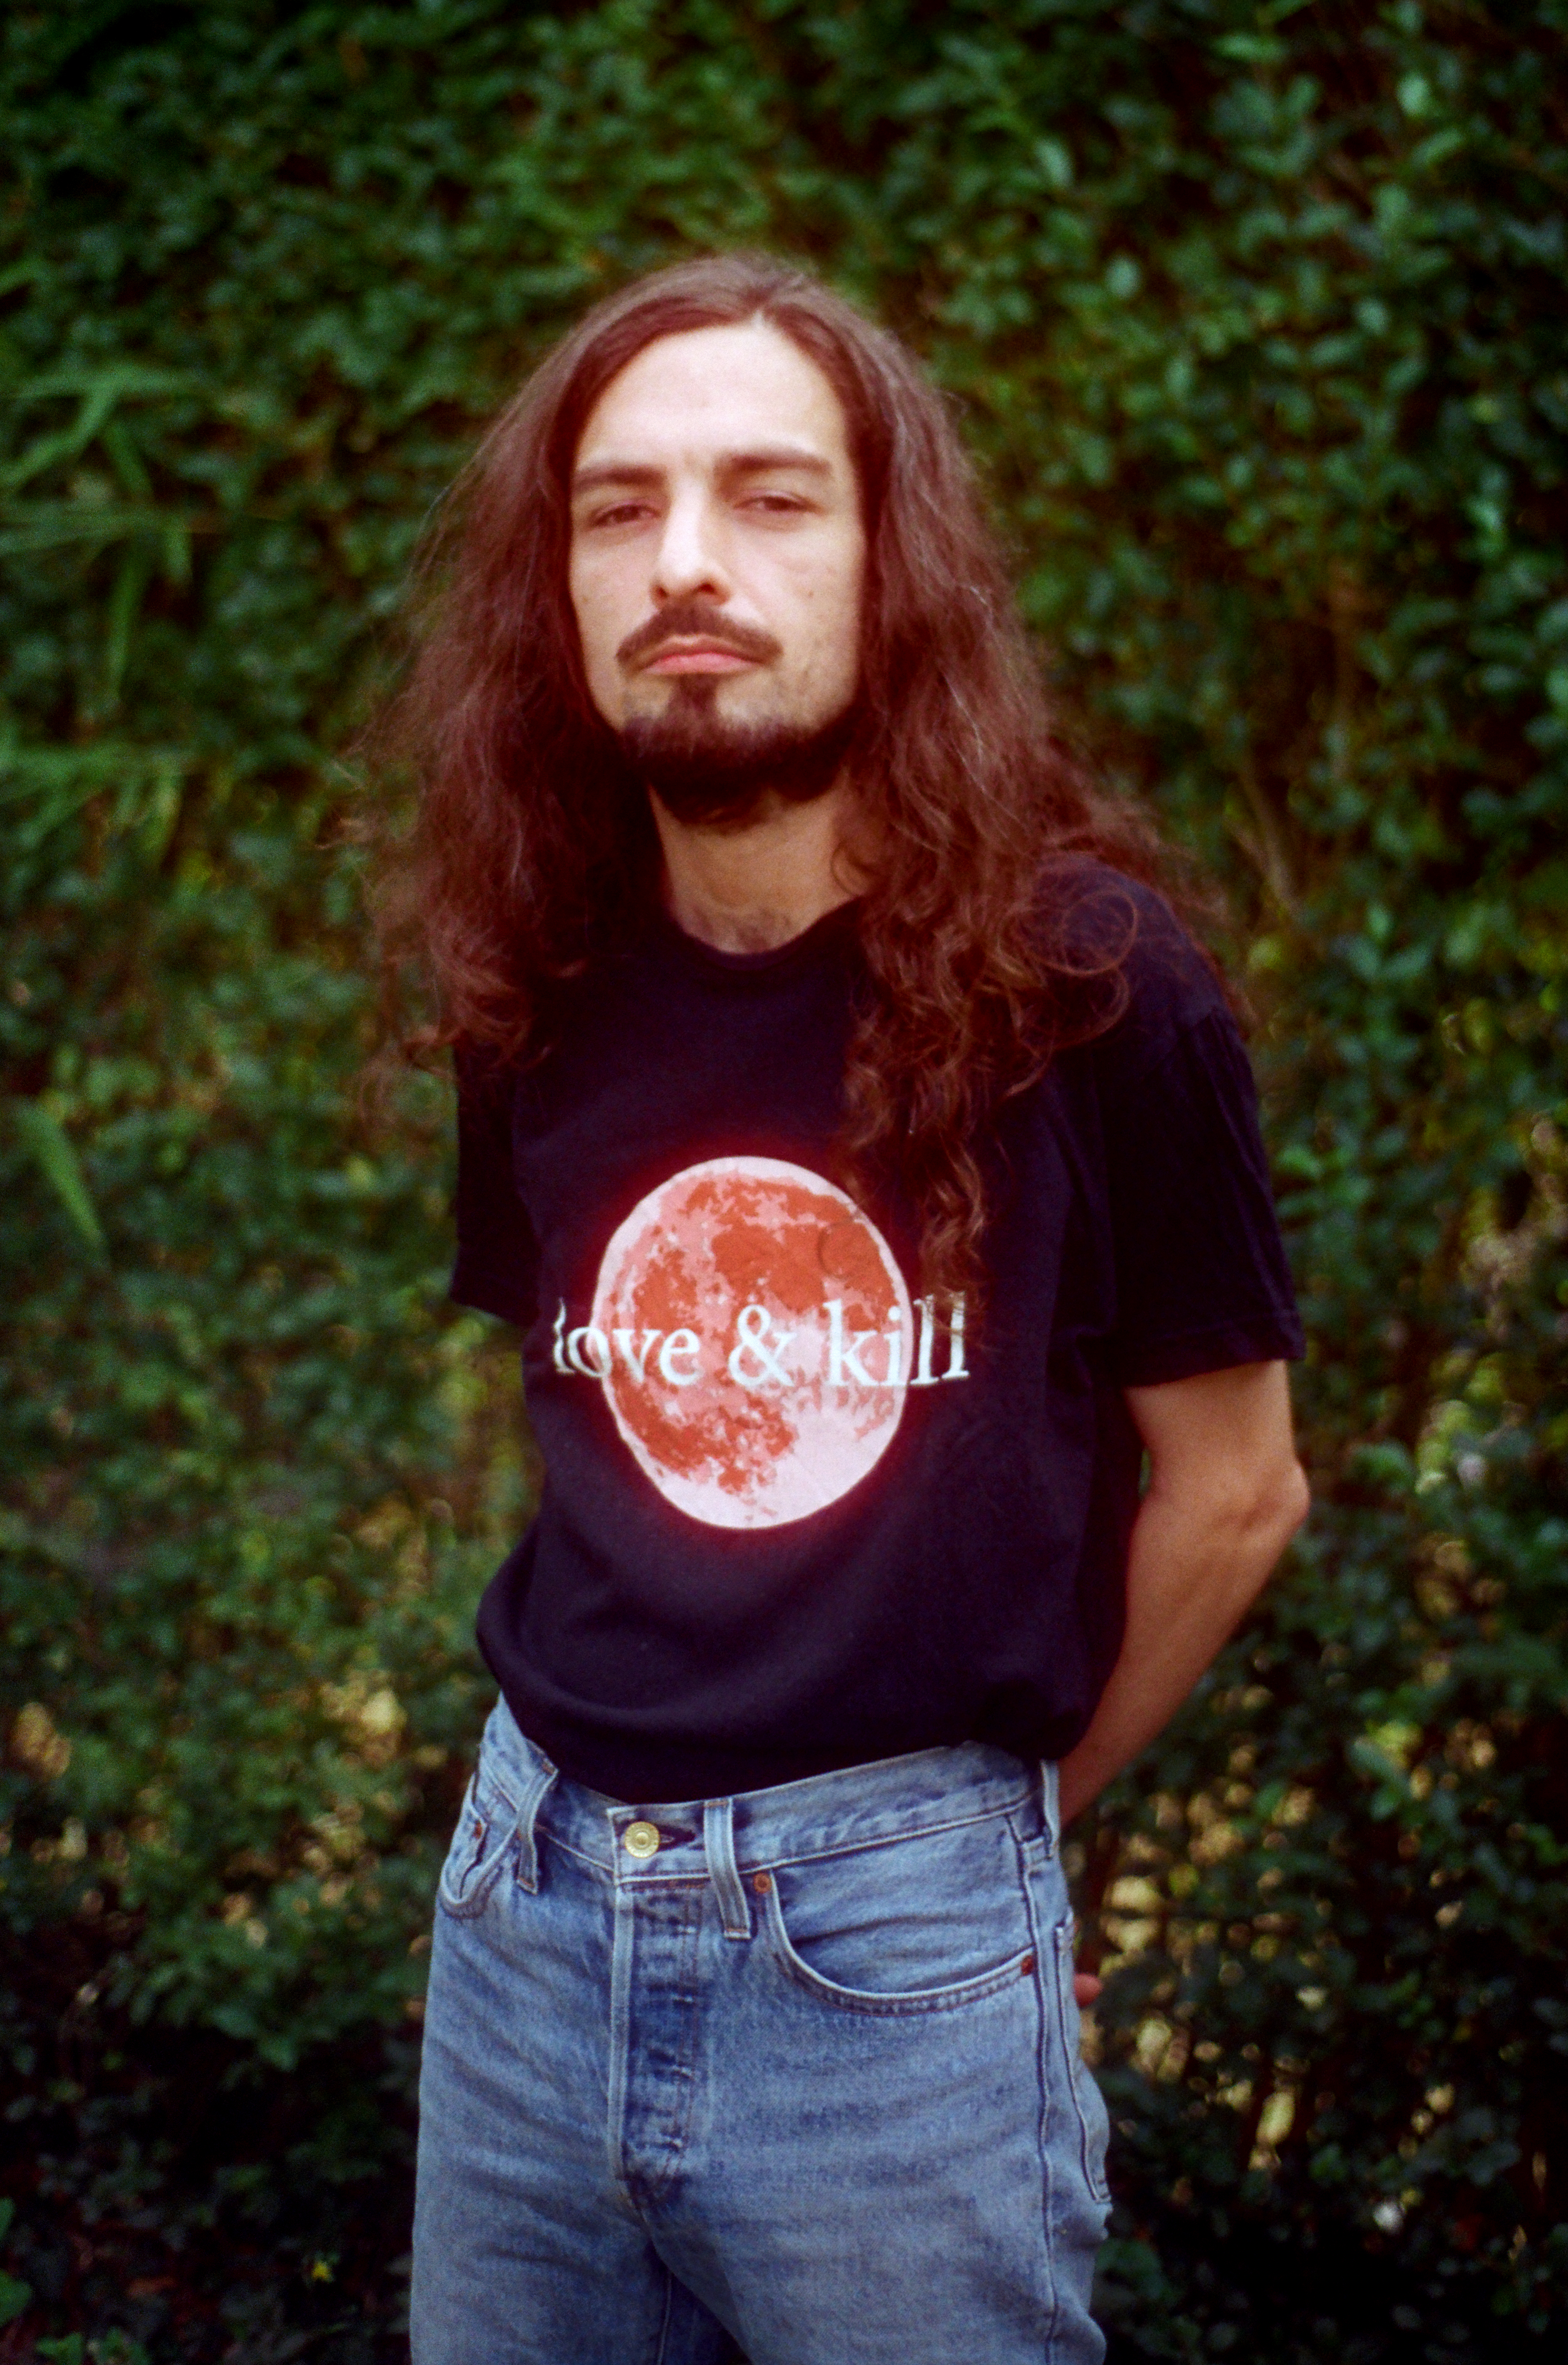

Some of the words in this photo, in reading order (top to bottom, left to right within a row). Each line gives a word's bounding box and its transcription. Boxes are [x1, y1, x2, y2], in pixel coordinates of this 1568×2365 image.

[553, 1296, 701, 1386] love
[728, 1303, 797, 1387] &
[822, 1290, 970, 1387] kill
